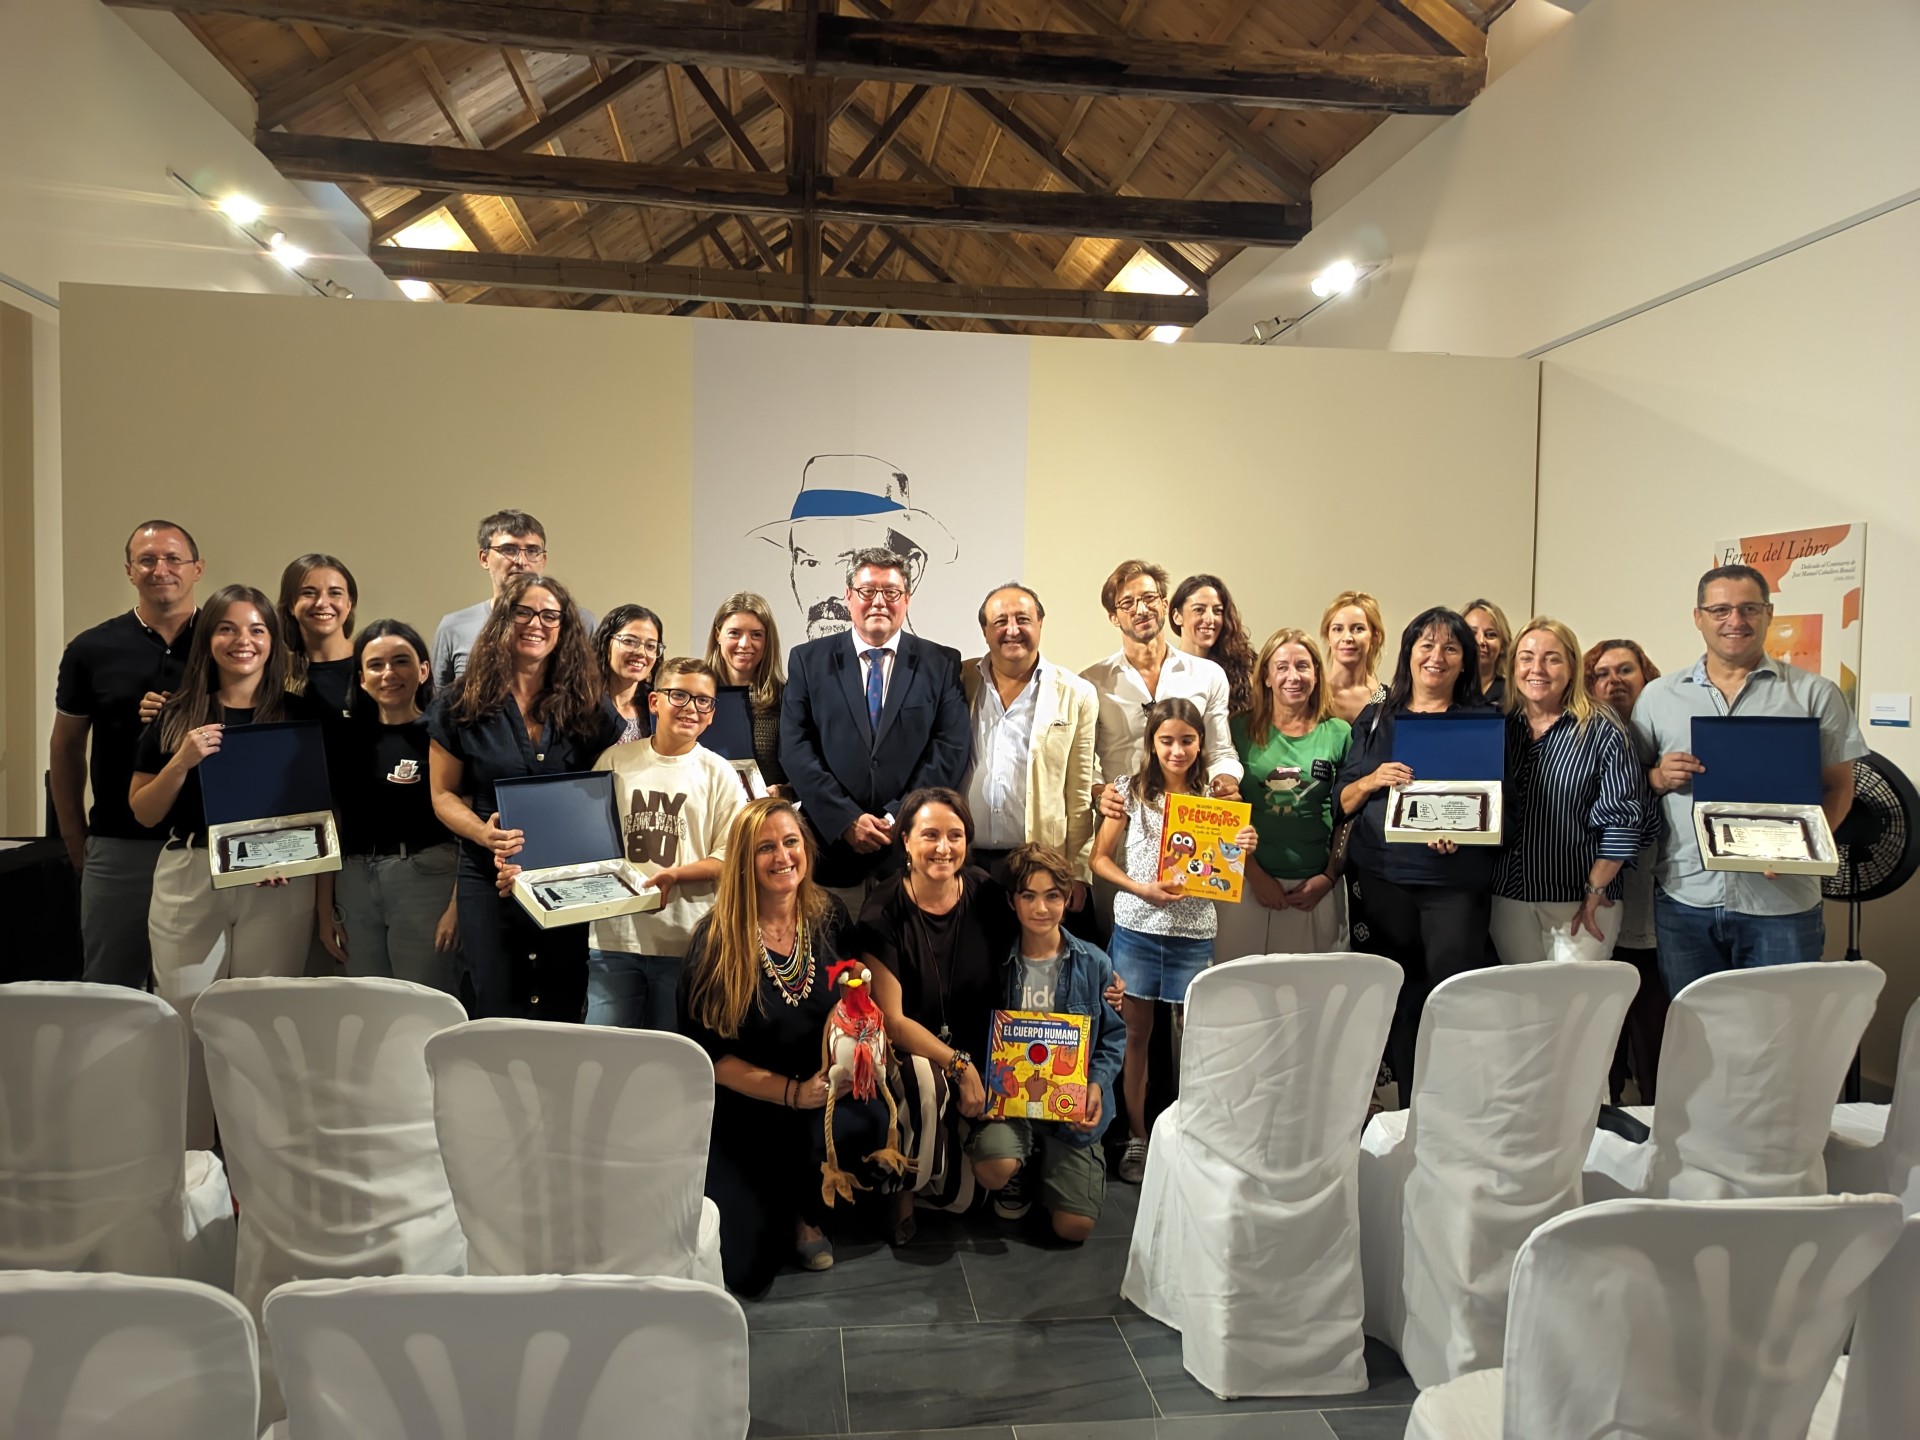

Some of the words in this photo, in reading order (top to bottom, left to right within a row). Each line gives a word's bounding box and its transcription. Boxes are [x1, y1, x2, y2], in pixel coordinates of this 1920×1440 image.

[1722, 546, 1758, 566] Feria
[1762, 541, 1783, 562] del
[1786, 538, 1830, 560] Libro
[655, 811, 687, 840] WAYS
[1177, 805, 1241, 828] PELUDITOS
[627, 829, 679, 868] 80
[1003, 1025, 1012, 1036] EL
[1013, 1026, 1043, 1039] CUERPO
[1044, 1028, 1079, 1041] HUMANO
